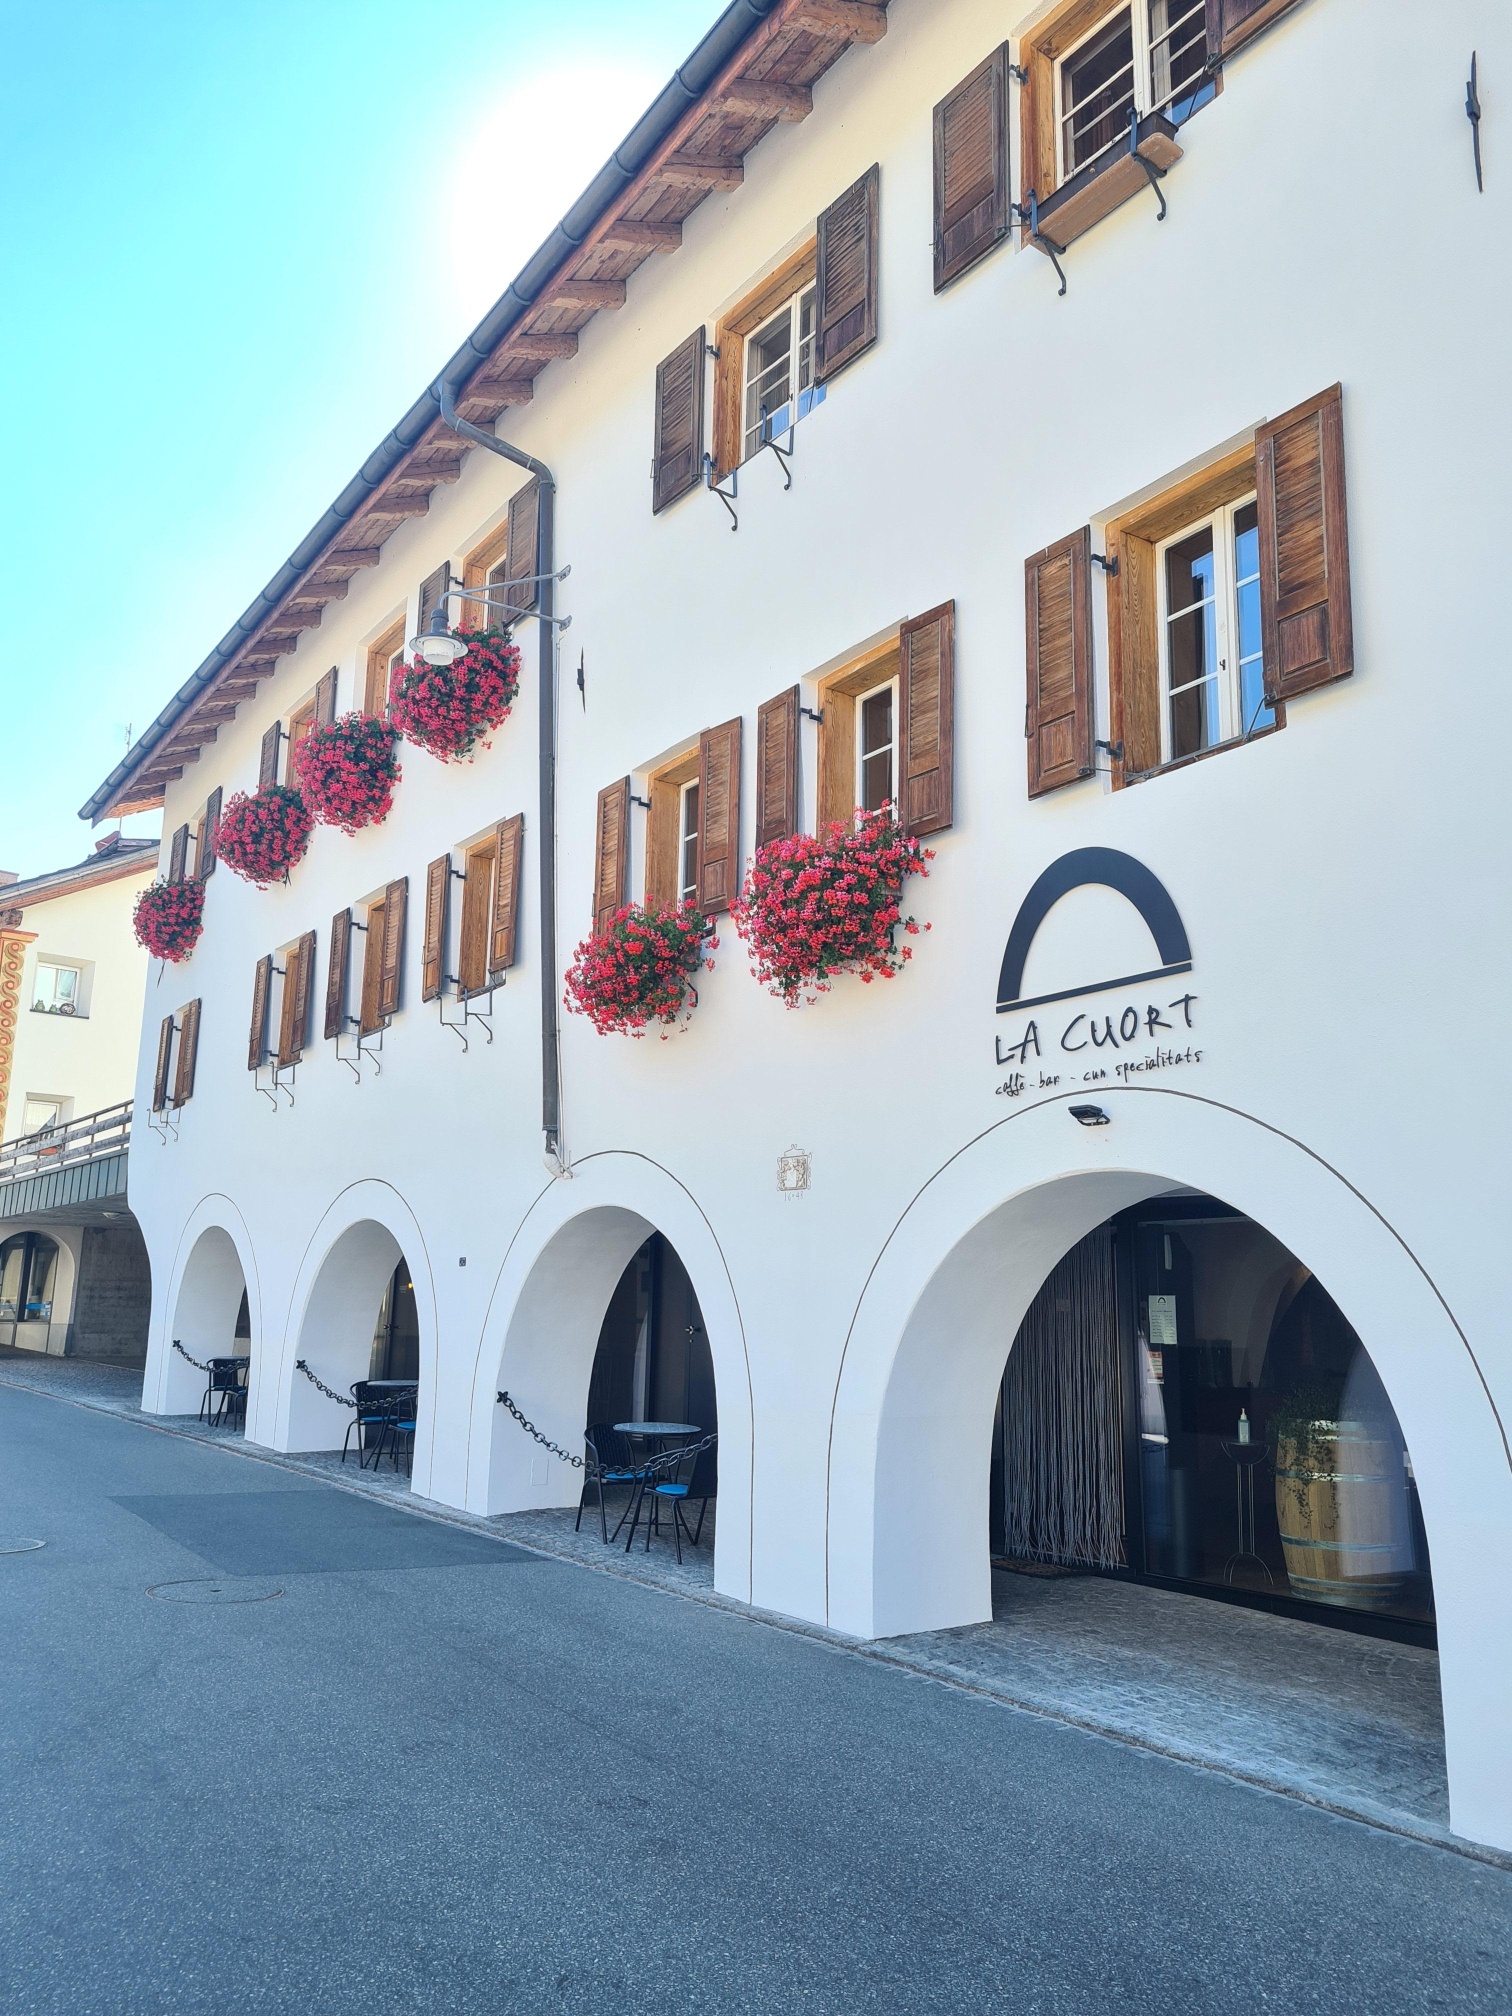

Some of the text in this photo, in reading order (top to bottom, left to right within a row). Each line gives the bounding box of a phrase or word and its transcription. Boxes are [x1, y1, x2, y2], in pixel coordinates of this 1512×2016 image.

[995, 993, 1198, 1065] LA CUORT
[1039, 1070, 1060, 1089] bar
